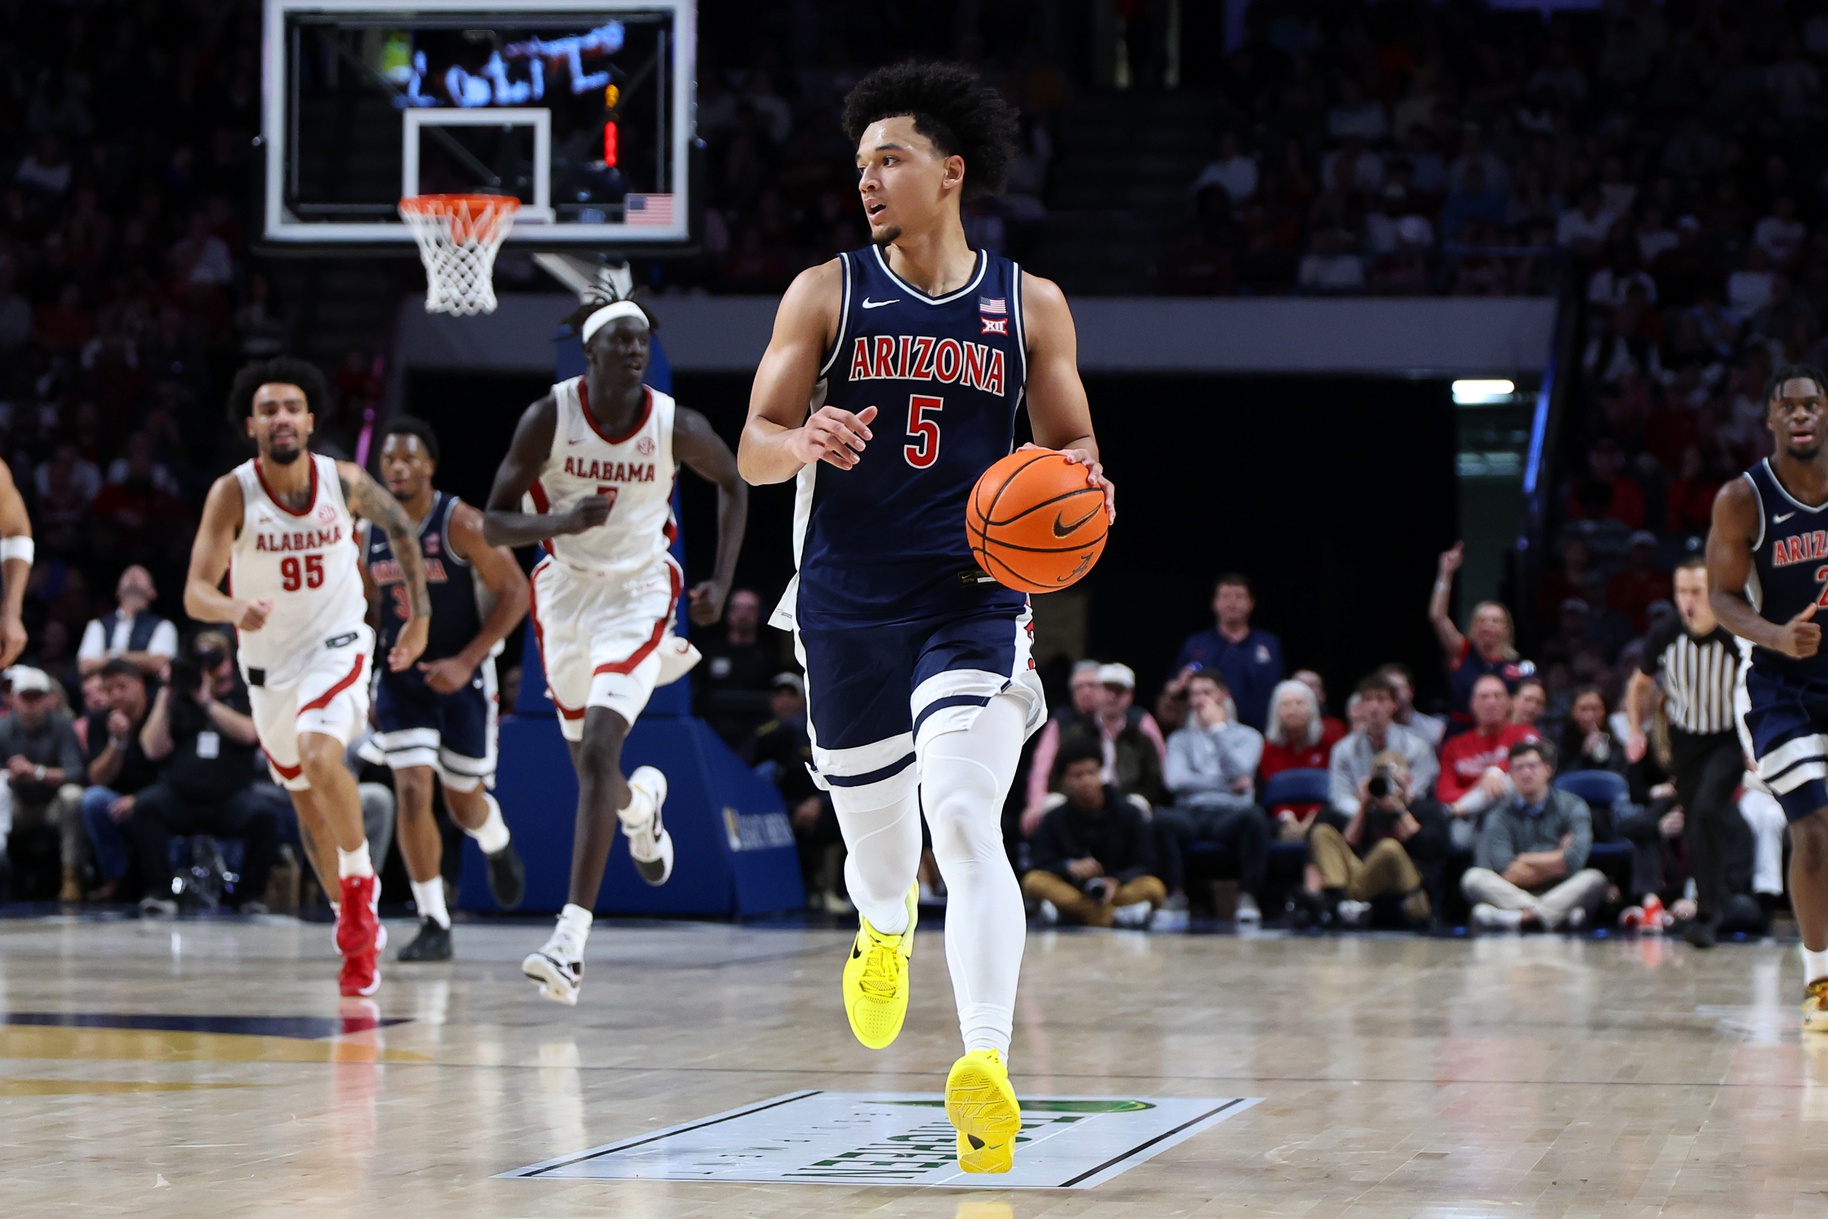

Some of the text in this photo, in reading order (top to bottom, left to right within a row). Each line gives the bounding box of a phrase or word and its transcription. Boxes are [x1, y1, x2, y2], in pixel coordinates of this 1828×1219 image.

[848, 335, 1006, 397] ARIZONA
[904, 394, 944, 469] 5
[564, 456, 655, 482] ALABAMA
[256, 526, 342, 551] ALABAMA
[1773, 529, 1828, 567] ARIZ
[281, 554, 324, 592] 95
[391, 584, 411, 620] 3
